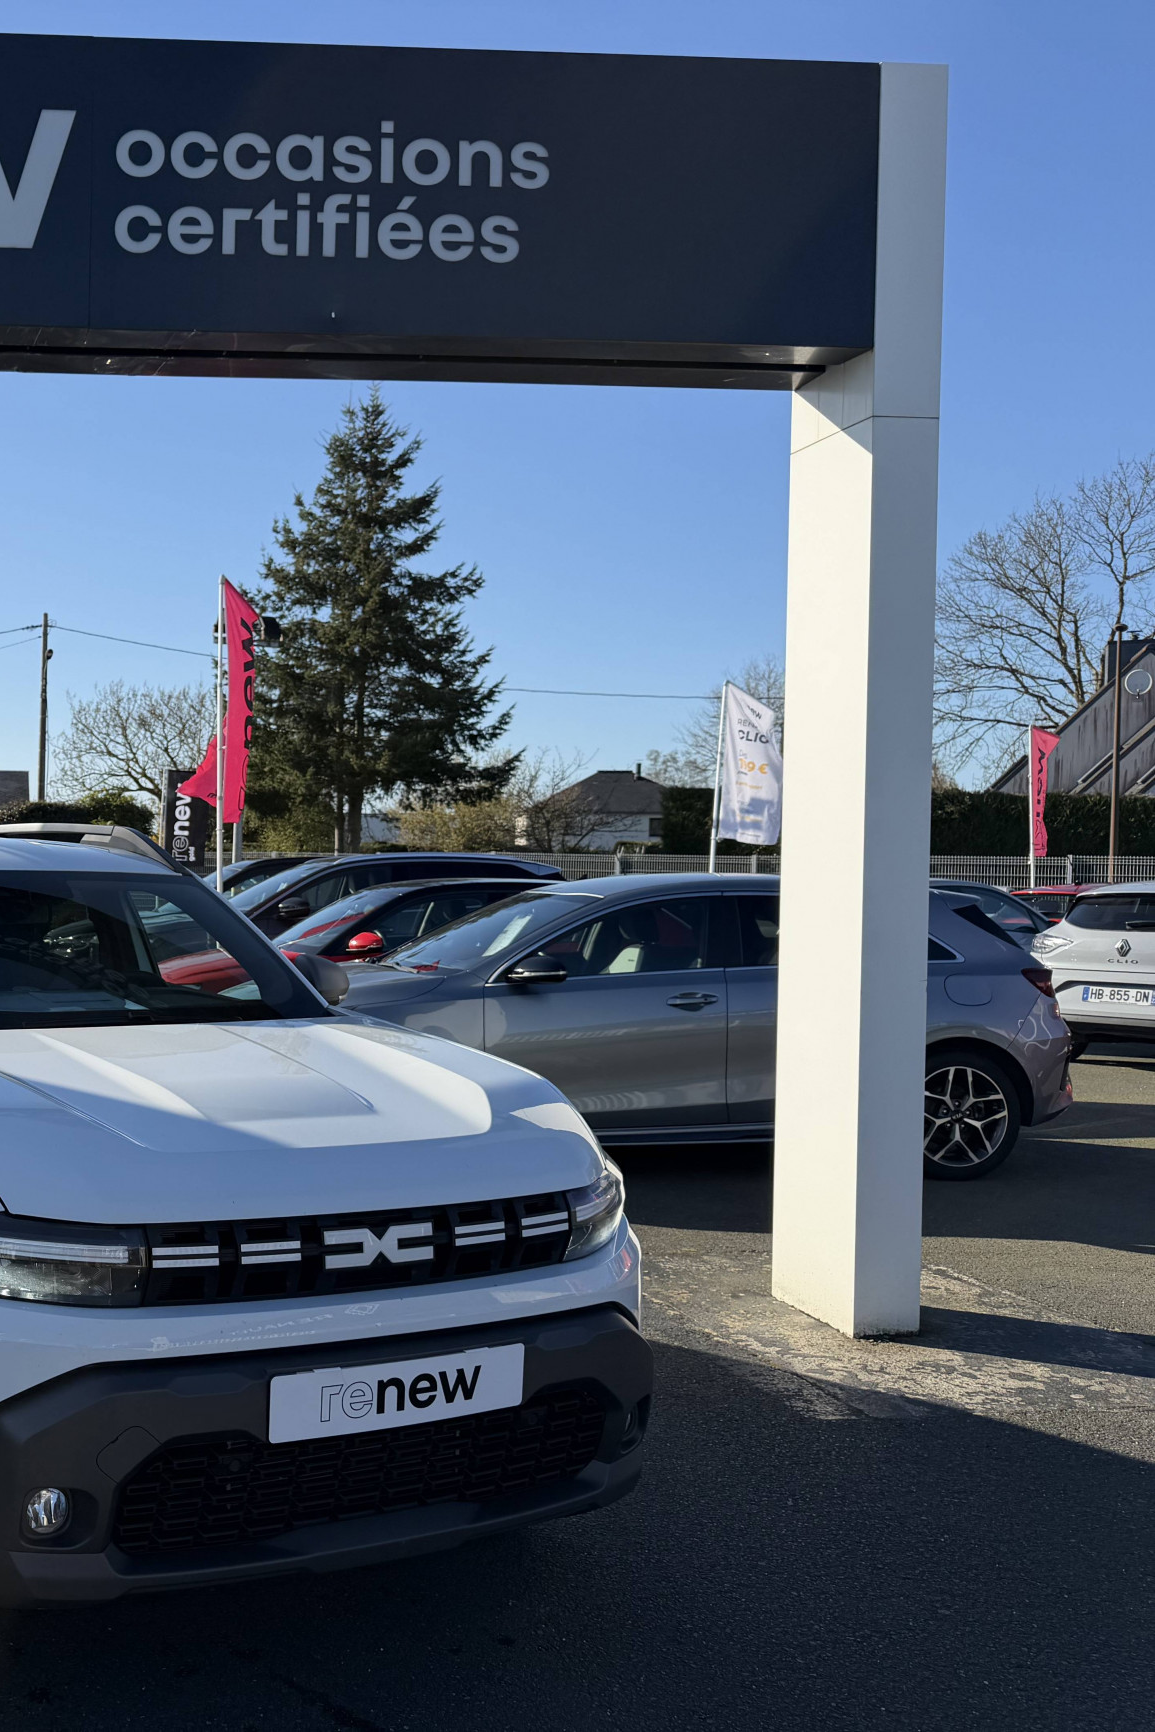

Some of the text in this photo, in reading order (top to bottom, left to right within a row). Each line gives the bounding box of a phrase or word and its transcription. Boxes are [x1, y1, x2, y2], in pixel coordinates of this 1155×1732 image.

[115, 120, 550, 189] occasions
[114, 192, 520, 264] certifiées
[1089, 988, 1150, 1003] HB-855-DN
[320, 1365, 482, 1423] renew
